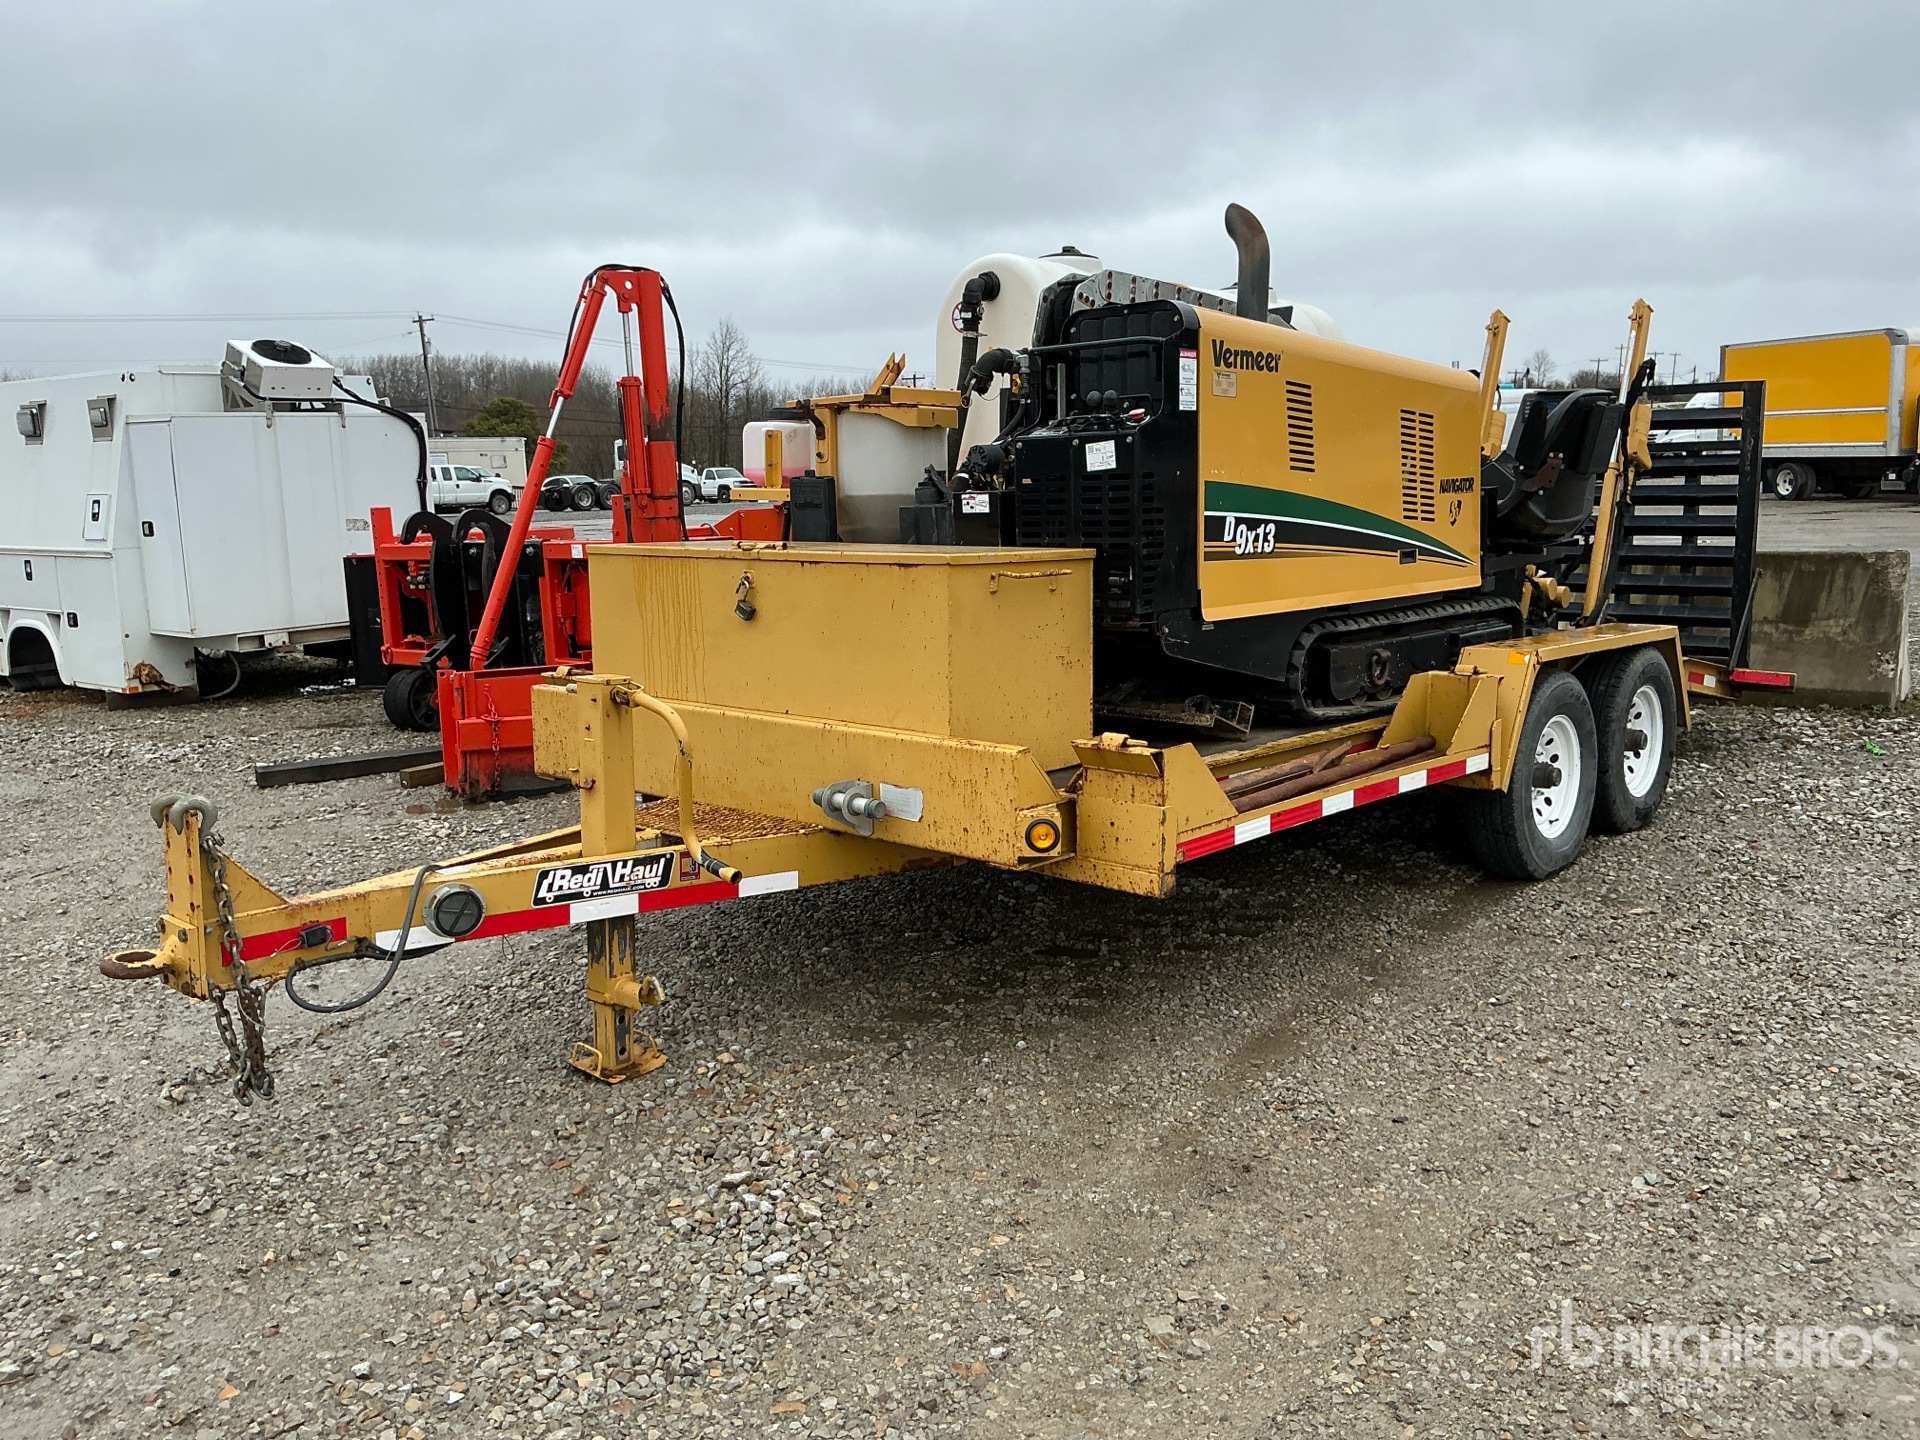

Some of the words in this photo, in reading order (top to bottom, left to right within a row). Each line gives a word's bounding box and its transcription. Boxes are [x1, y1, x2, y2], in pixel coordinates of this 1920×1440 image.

[1211, 339, 1281, 373] Vermeer
[1439, 477, 1475, 494] NAVIGATOR
[552, 867, 604, 892] Redi
[613, 857, 666, 882] Haul
